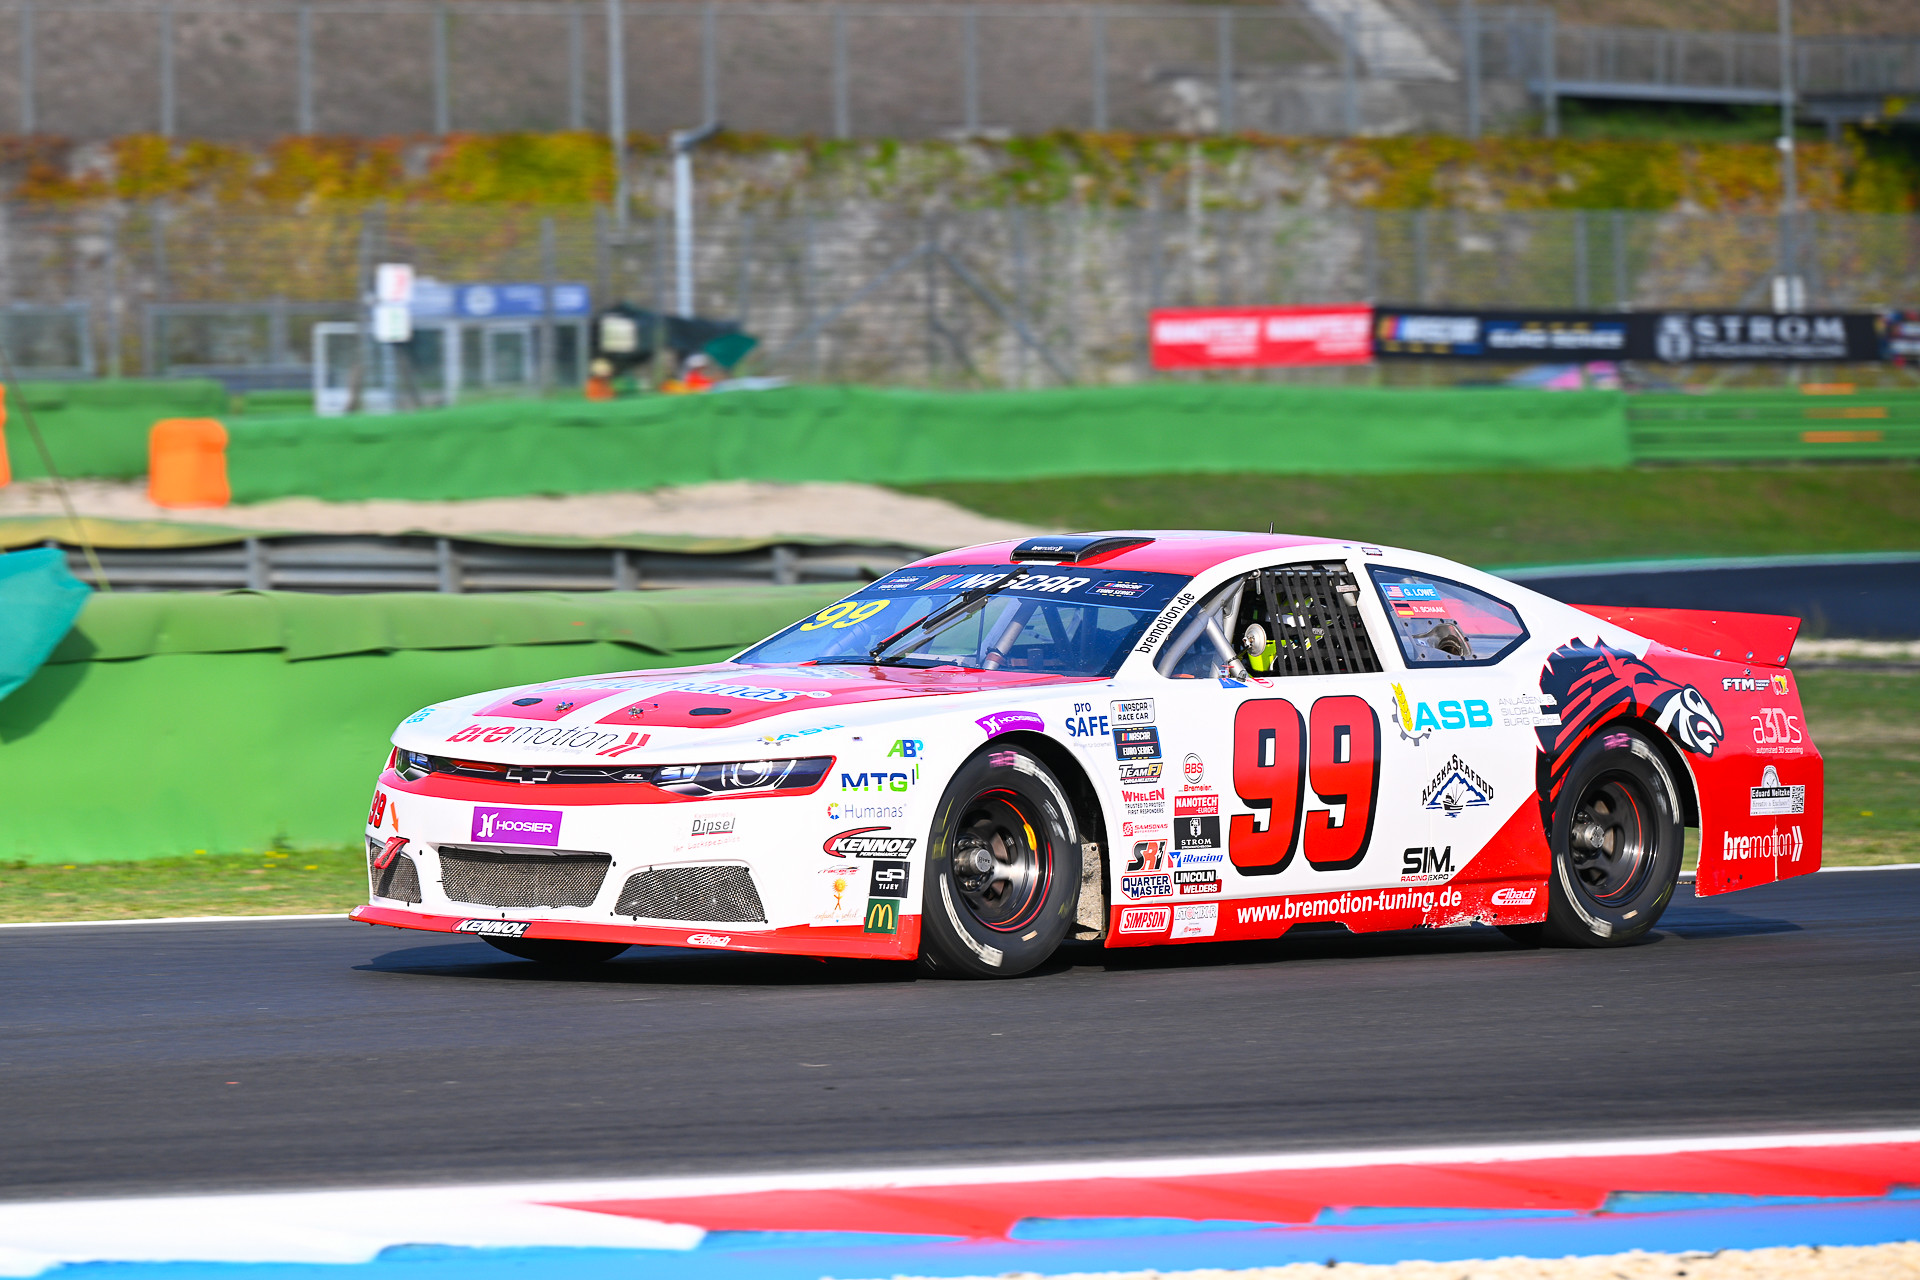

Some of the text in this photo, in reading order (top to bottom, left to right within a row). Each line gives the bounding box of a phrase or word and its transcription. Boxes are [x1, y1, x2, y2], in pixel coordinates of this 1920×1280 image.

[1693, 315, 1845, 342] STROM
[1404, 588, 1437, 597] G. LOWE
[800, 600, 891, 631] 99
[1135, 593, 1195, 654] bremotion.de
[1721, 677, 1755, 692] FTM
[1073, 702, 1092, 716] pro
[1123, 702, 1149, 712] NASCAR
[1117, 712, 1149, 721] RACE CAR
[1414, 699, 1494, 732] ASB
[1503, 717, 1530, 727] BURG
[1065, 715, 1110, 738] SAFE
[445, 723, 620, 750] bremotion
[1129, 731, 1151, 741] NASCAR
[1784, 747, 1804, 755] scanning
[1184, 762, 1203, 774] BBS
[841, 772, 908, 792] MTG
[1228, 695, 1382, 876] 99
[1421, 753, 1494, 806] ALASKA SEAFOOD
[1751, 788, 1770, 798] Eduard
[367, 789, 388, 829] 99
[1175, 796, 1218, 808] NANOTECH
[844, 803, 903, 819] Humanas
[495, 820, 553, 834] HOOSIER
[691, 817, 736, 835] Dipsel
[829, 838, 912, 853] KENNOL
[1181, 838, 1212, 846] STROM
[1722, 828, 1792, 861] bremotion
[1183, 853, 1223, 863] iRacing
[1122, 875, 1169, 892] QUARTER
[1175, 870, 1215, 884] LINCOLN
[1400, 873, 1449, 882] RACING EXPO
[1131, 885, 1171, 898] MASTER
[1183, 883, 1218, 894] WELDERS
[1237, 885, 1463, 924] www.bremotion-tuning.de
[455, 920, 528, 935] KENNOL
[1123, 911, 1167, 929] SIMPSON
